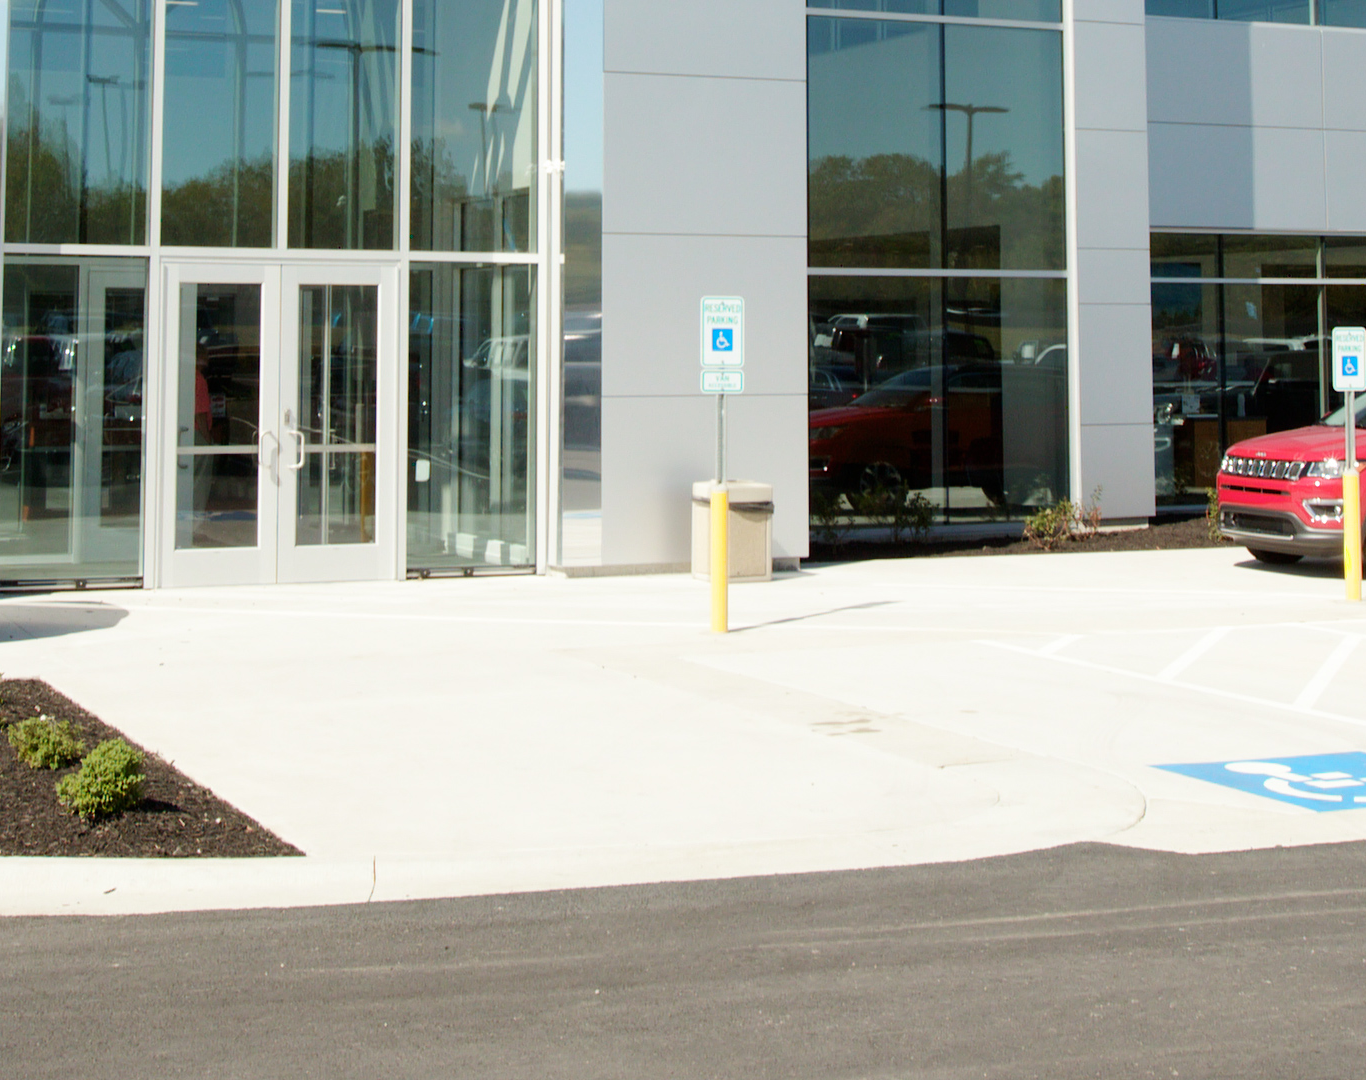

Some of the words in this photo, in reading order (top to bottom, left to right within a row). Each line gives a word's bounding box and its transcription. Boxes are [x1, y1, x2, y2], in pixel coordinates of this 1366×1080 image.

[704, 303, 741, 314] RESERVED
[706, 315, 738, 325] PARKING
[1337, 344, 1362, 352] PARKING
[715, 374, 730, 382] VAN
